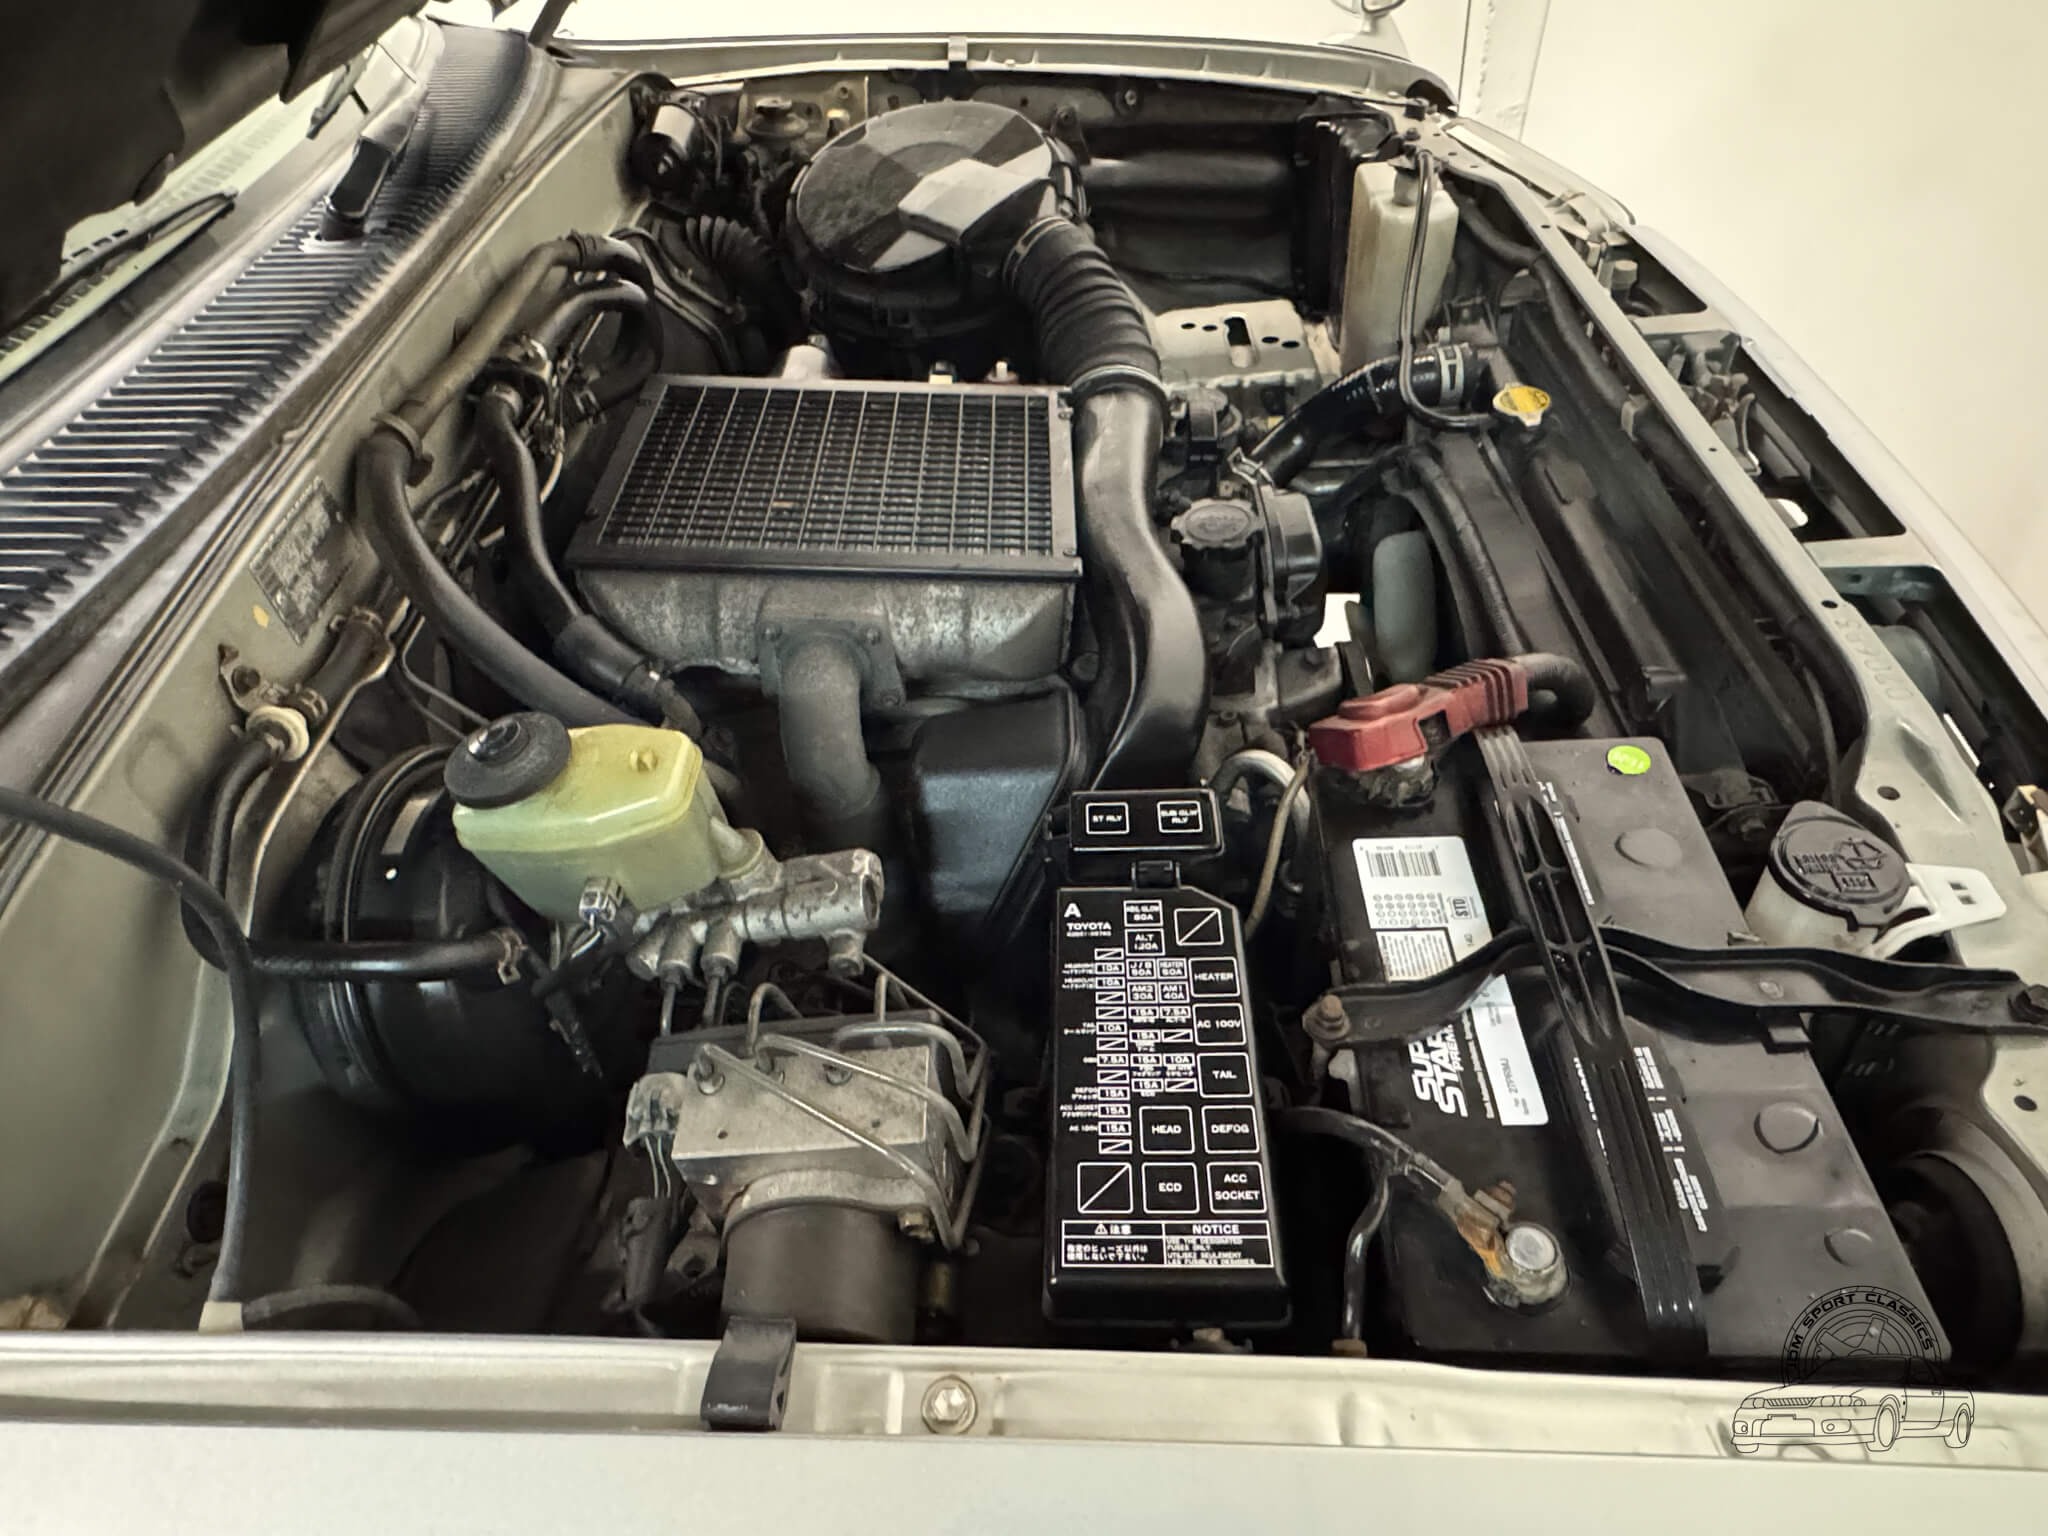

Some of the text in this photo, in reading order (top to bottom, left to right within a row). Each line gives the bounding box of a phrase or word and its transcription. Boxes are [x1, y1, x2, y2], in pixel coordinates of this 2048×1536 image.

[1064, 902, 1081, 918] A
[1066, 921, 1112, 931] TOYOTA
[1135, 933, 1154, 941] ALT
[1134, 943, 1158, 951] 120A
[1102, 964, 1120, 972] 10A
[1194, 972, 1234, 981] HEATER
[1102, 979, 1120, 987] 10A
[1132, 984, 1154, 992] AM2
[1163, 984, 1183, 992] AM1
[1133, 992, 1154, 1000] 30A
[1163, 992, 1185, 1000] 40A
[1104, 1024, 1121, 1032] 10A
[1197, 1020, 1241, 1028] AC 100V
[1444, 1024, 1464, 1072] PREM
[1170, 1056, 1189, 1064] 10A
[1212, 1070, 1238, 1079] TAIL
[1408, 1040, 1441, 1103] SUP
[1426, 1030, 1468, 1117] STAR
[1105, 1089, 1125, 1097] 15A
[1106, 1106, 1126, 1115] 15A
[1106, 1124, 1126, 1132] 15A
[1151, 1124, 1182, 1134] HEAD
[1211, 1124, 1250, 1133] DEFOG
[1223, 1174, 1248, 1183] ACC
[1158, 1183, 1183, 1192] ECD
[1214, 1191, 1260, 1200] SOCKET
[1192, 1224, 1240, 1234] NOTICE
